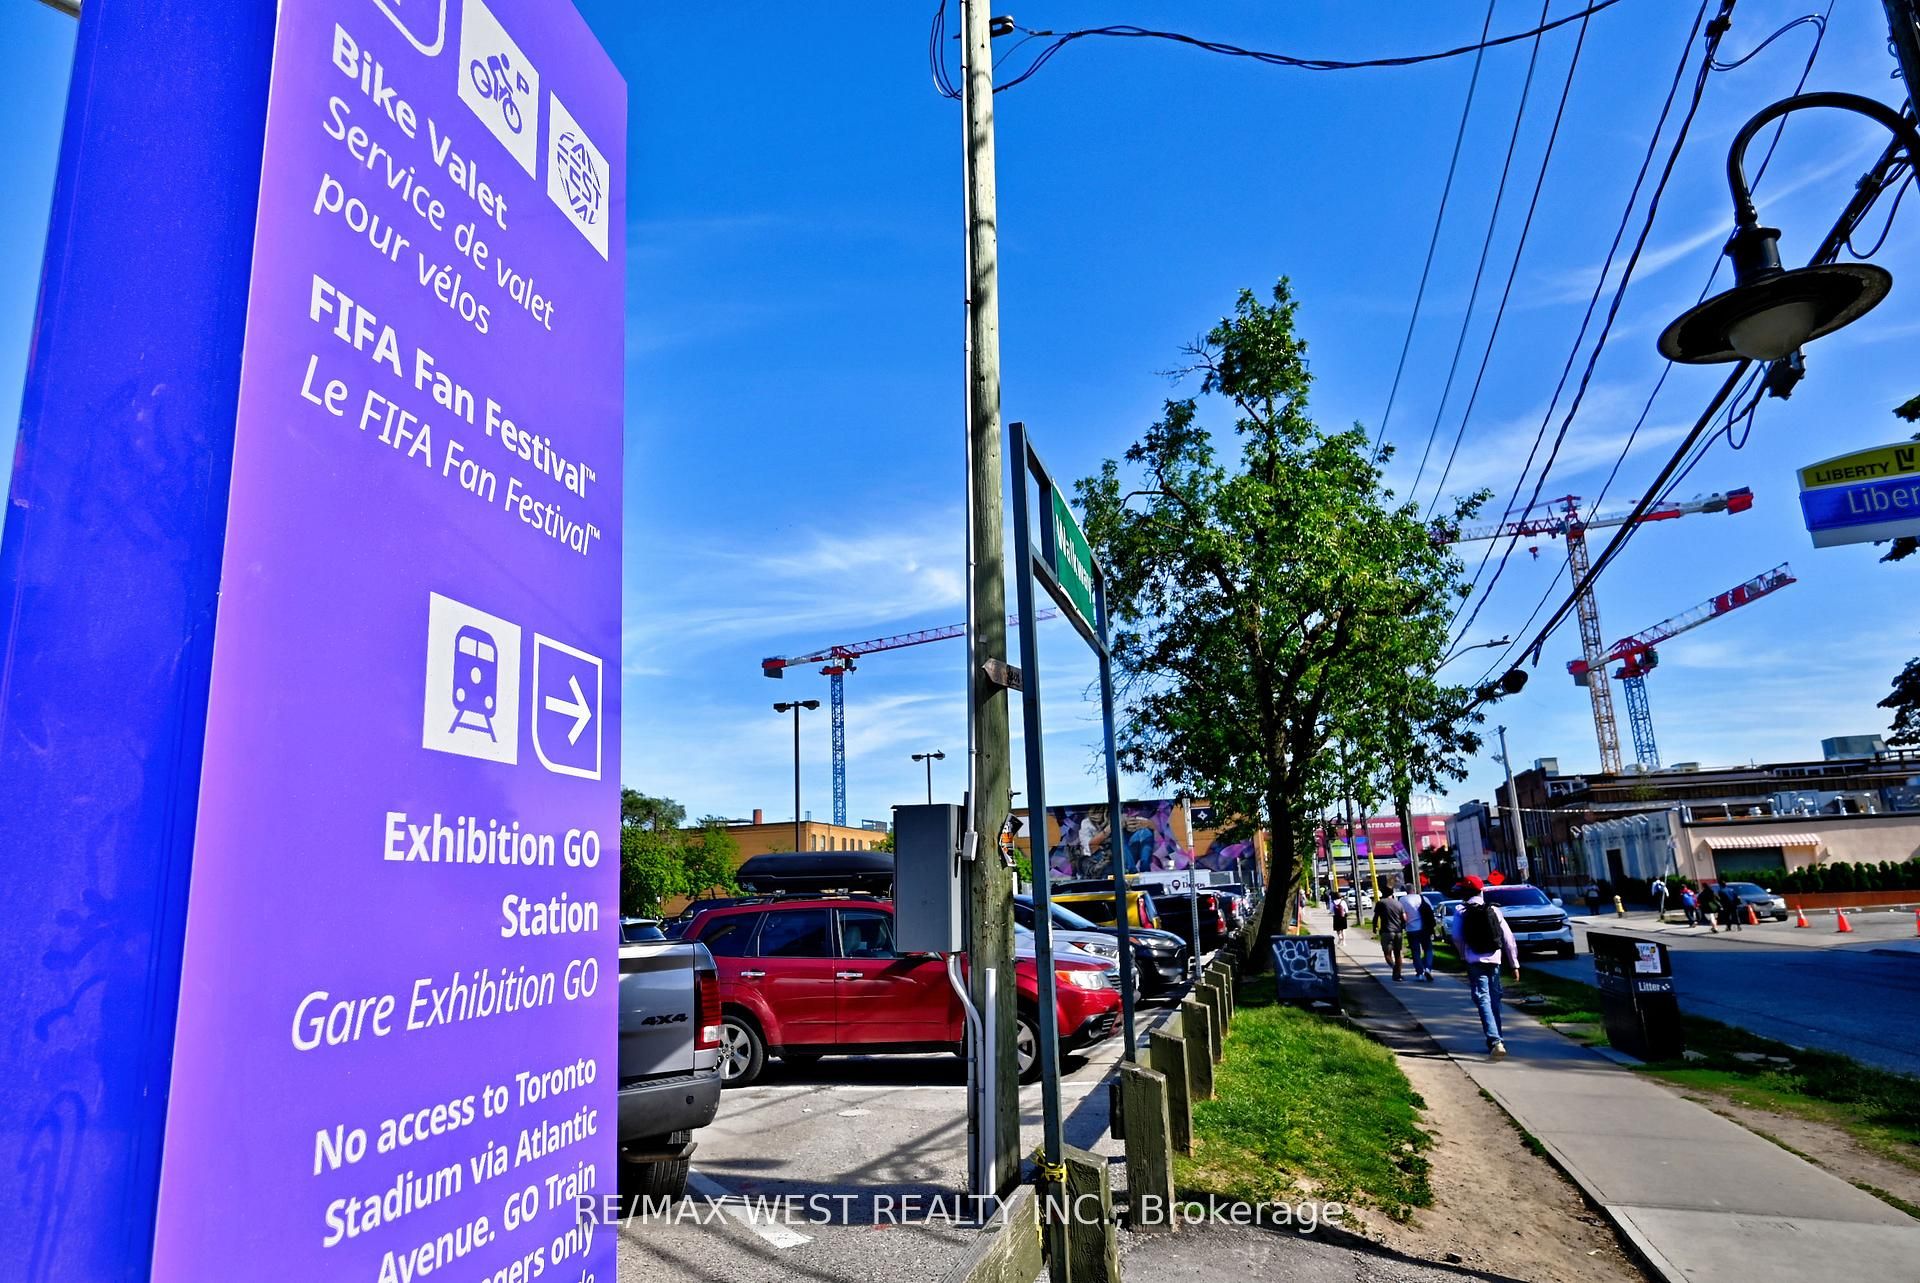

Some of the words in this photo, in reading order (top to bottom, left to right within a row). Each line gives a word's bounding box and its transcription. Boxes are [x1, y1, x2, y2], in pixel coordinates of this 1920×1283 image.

[333, 23, 417, 139] Bike
[428, 118, 508, 231] Valet
[313, 173, 410, 262] pour
[418, 252, 491, 334] vélos
[323, 96, 446, 232] Service
[454, 222, 489, 271] de
[497, 257, 554, 331] valet
[310, 274, 403, 378] FIFA
[415, 347, 475, 425] Fan
[301, 354, 348, 417] Le
[360, 389, 432, 468] FIFA
[443, 439, 497, 503] Fan
[1815, 461, 1889, 483] LIBERTY
[1055, 513, 1092, 604] Walkway
[383, 811, 555, 866] Exhibition
[563, 828, 601, 868] GO
[501, 892, 599, 938] Station
[291, 991, 395, 1051] Gare
[406, 965, 555, 1031] Exhibition
[563, 957, 599, 1001] GO
[1638, 982, 1661, 992] Litter
[313, 1124, 367, 1176] No
[377, 1095, 475, 1154] access
[483, 1084, 509, 1119] to
[516, 1057, 597, 1107] Toronto
[323, 1163, 462, 1248] Stadium
[471, 1141, 508, 1185] via
[515, 1105, 598, 1168] Atlantic
[378, 1216, 496, 1283] Avenue.
[504, 1185, 539, 1231] GO
[545, 1161, 596, 1210] Train
[551, 1213, 596, 1265] only
